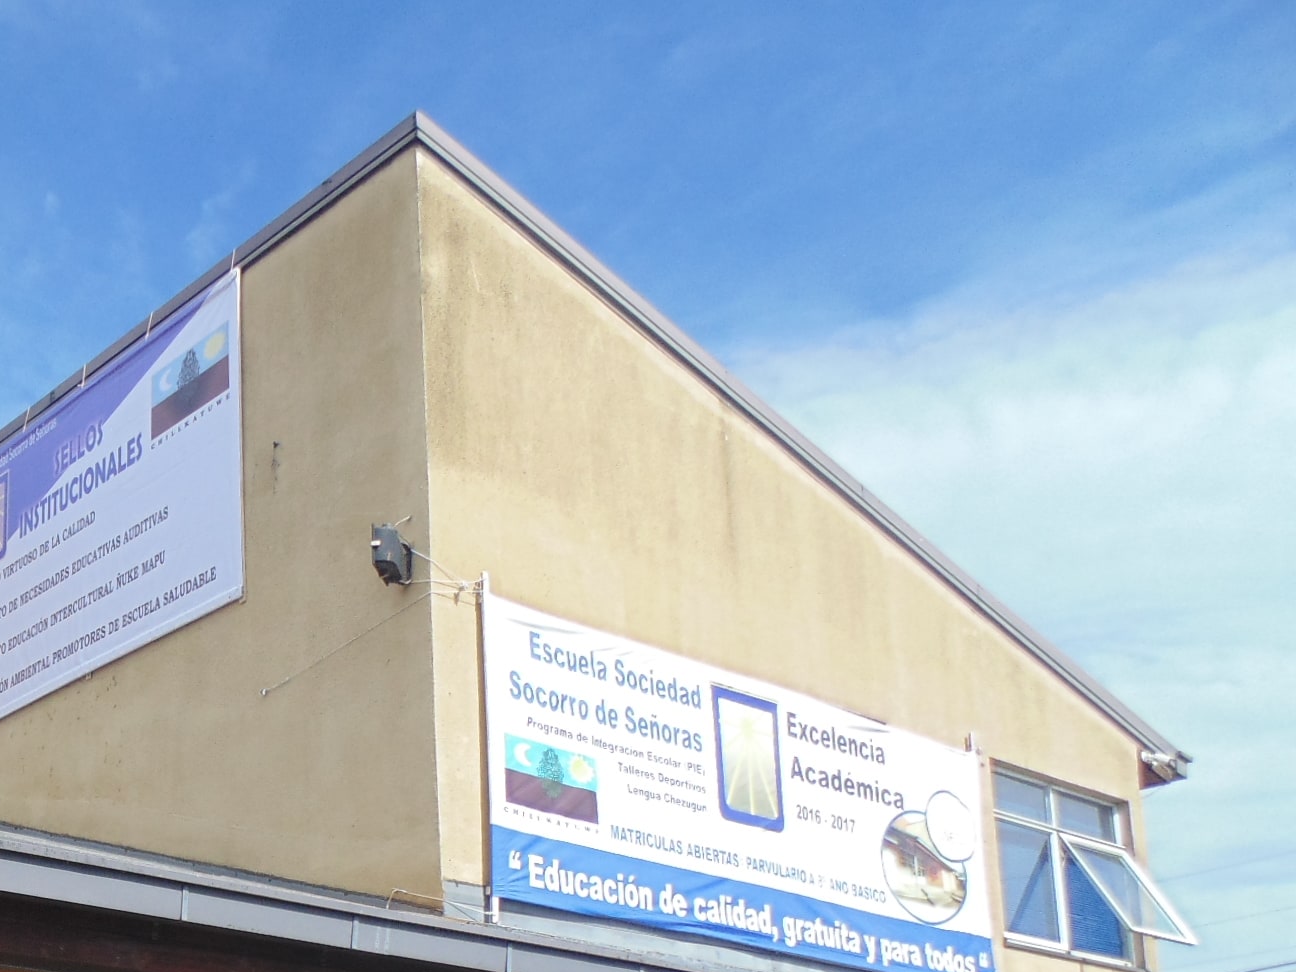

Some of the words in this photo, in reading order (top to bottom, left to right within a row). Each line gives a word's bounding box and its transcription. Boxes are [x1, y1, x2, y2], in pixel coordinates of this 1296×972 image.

[54, 421, 104, 474] SELLOS
[18, 432, 143, 540] INSTITUCIONALES
[2, 548, 38, 581] VIRTUOSO
[39, 540, 50, 558] DE
[51, 535, 61, 550] LA
[62, 510, 96, 541] CALIDAD
[8, 598, 18, 613] DE
[19, 566, 70, 607] NECESIDADES
[71, 535, 121, 575] EDUCATIVAS
[122, 506, 169, 545] AUDITIVAS
[7, 616, 49, 652] EDUCACIÓN
[50, 583, 114, 629] INTERCULTURAL
[9, 655, 51, 688] AMBIENTAL
[52, 625, 106, 664] PROMOTORES
[107, 617, 120, 634] DE
[121, 595, 161, 627] ESCUELA
[162, 565, 217, 607] SALUDABLE
[529, 630, 607, 682] Escuela
[614, 658, 702, 710] Sociedad
[508, 669, 589, 721] Socorro
[595, 699, 619, 730] de
[624, 706, 703, 753] Señoras
[527, 716, 574, 741] Programa
[576, 731, 589, 744] de
[646, 751, 682, 770] Escolar
[786, 711, 886, 766] Excelencia
[617, 761, 656, 781] Talleres
[657, 772, 707, 795] Deportivos
[627, 783, 662, 804] Lengua
[790, 755, 905, 812] Académica
[796, 804, 822, 826] 2016
[831, 813, 856, 834] 2017
[610, 824, 684, 856] MATRICULAS
[746, 857, 808, 884] PARVULARIO
[527, 852, 653, 912] Educación
[658, 883, 689, 918] de
[693, 894, 778, 942] calidad,
[782, 914, 862, 954] gratuita
[864, 934, 877, 964] y
[879, 937, 923, 967] para
